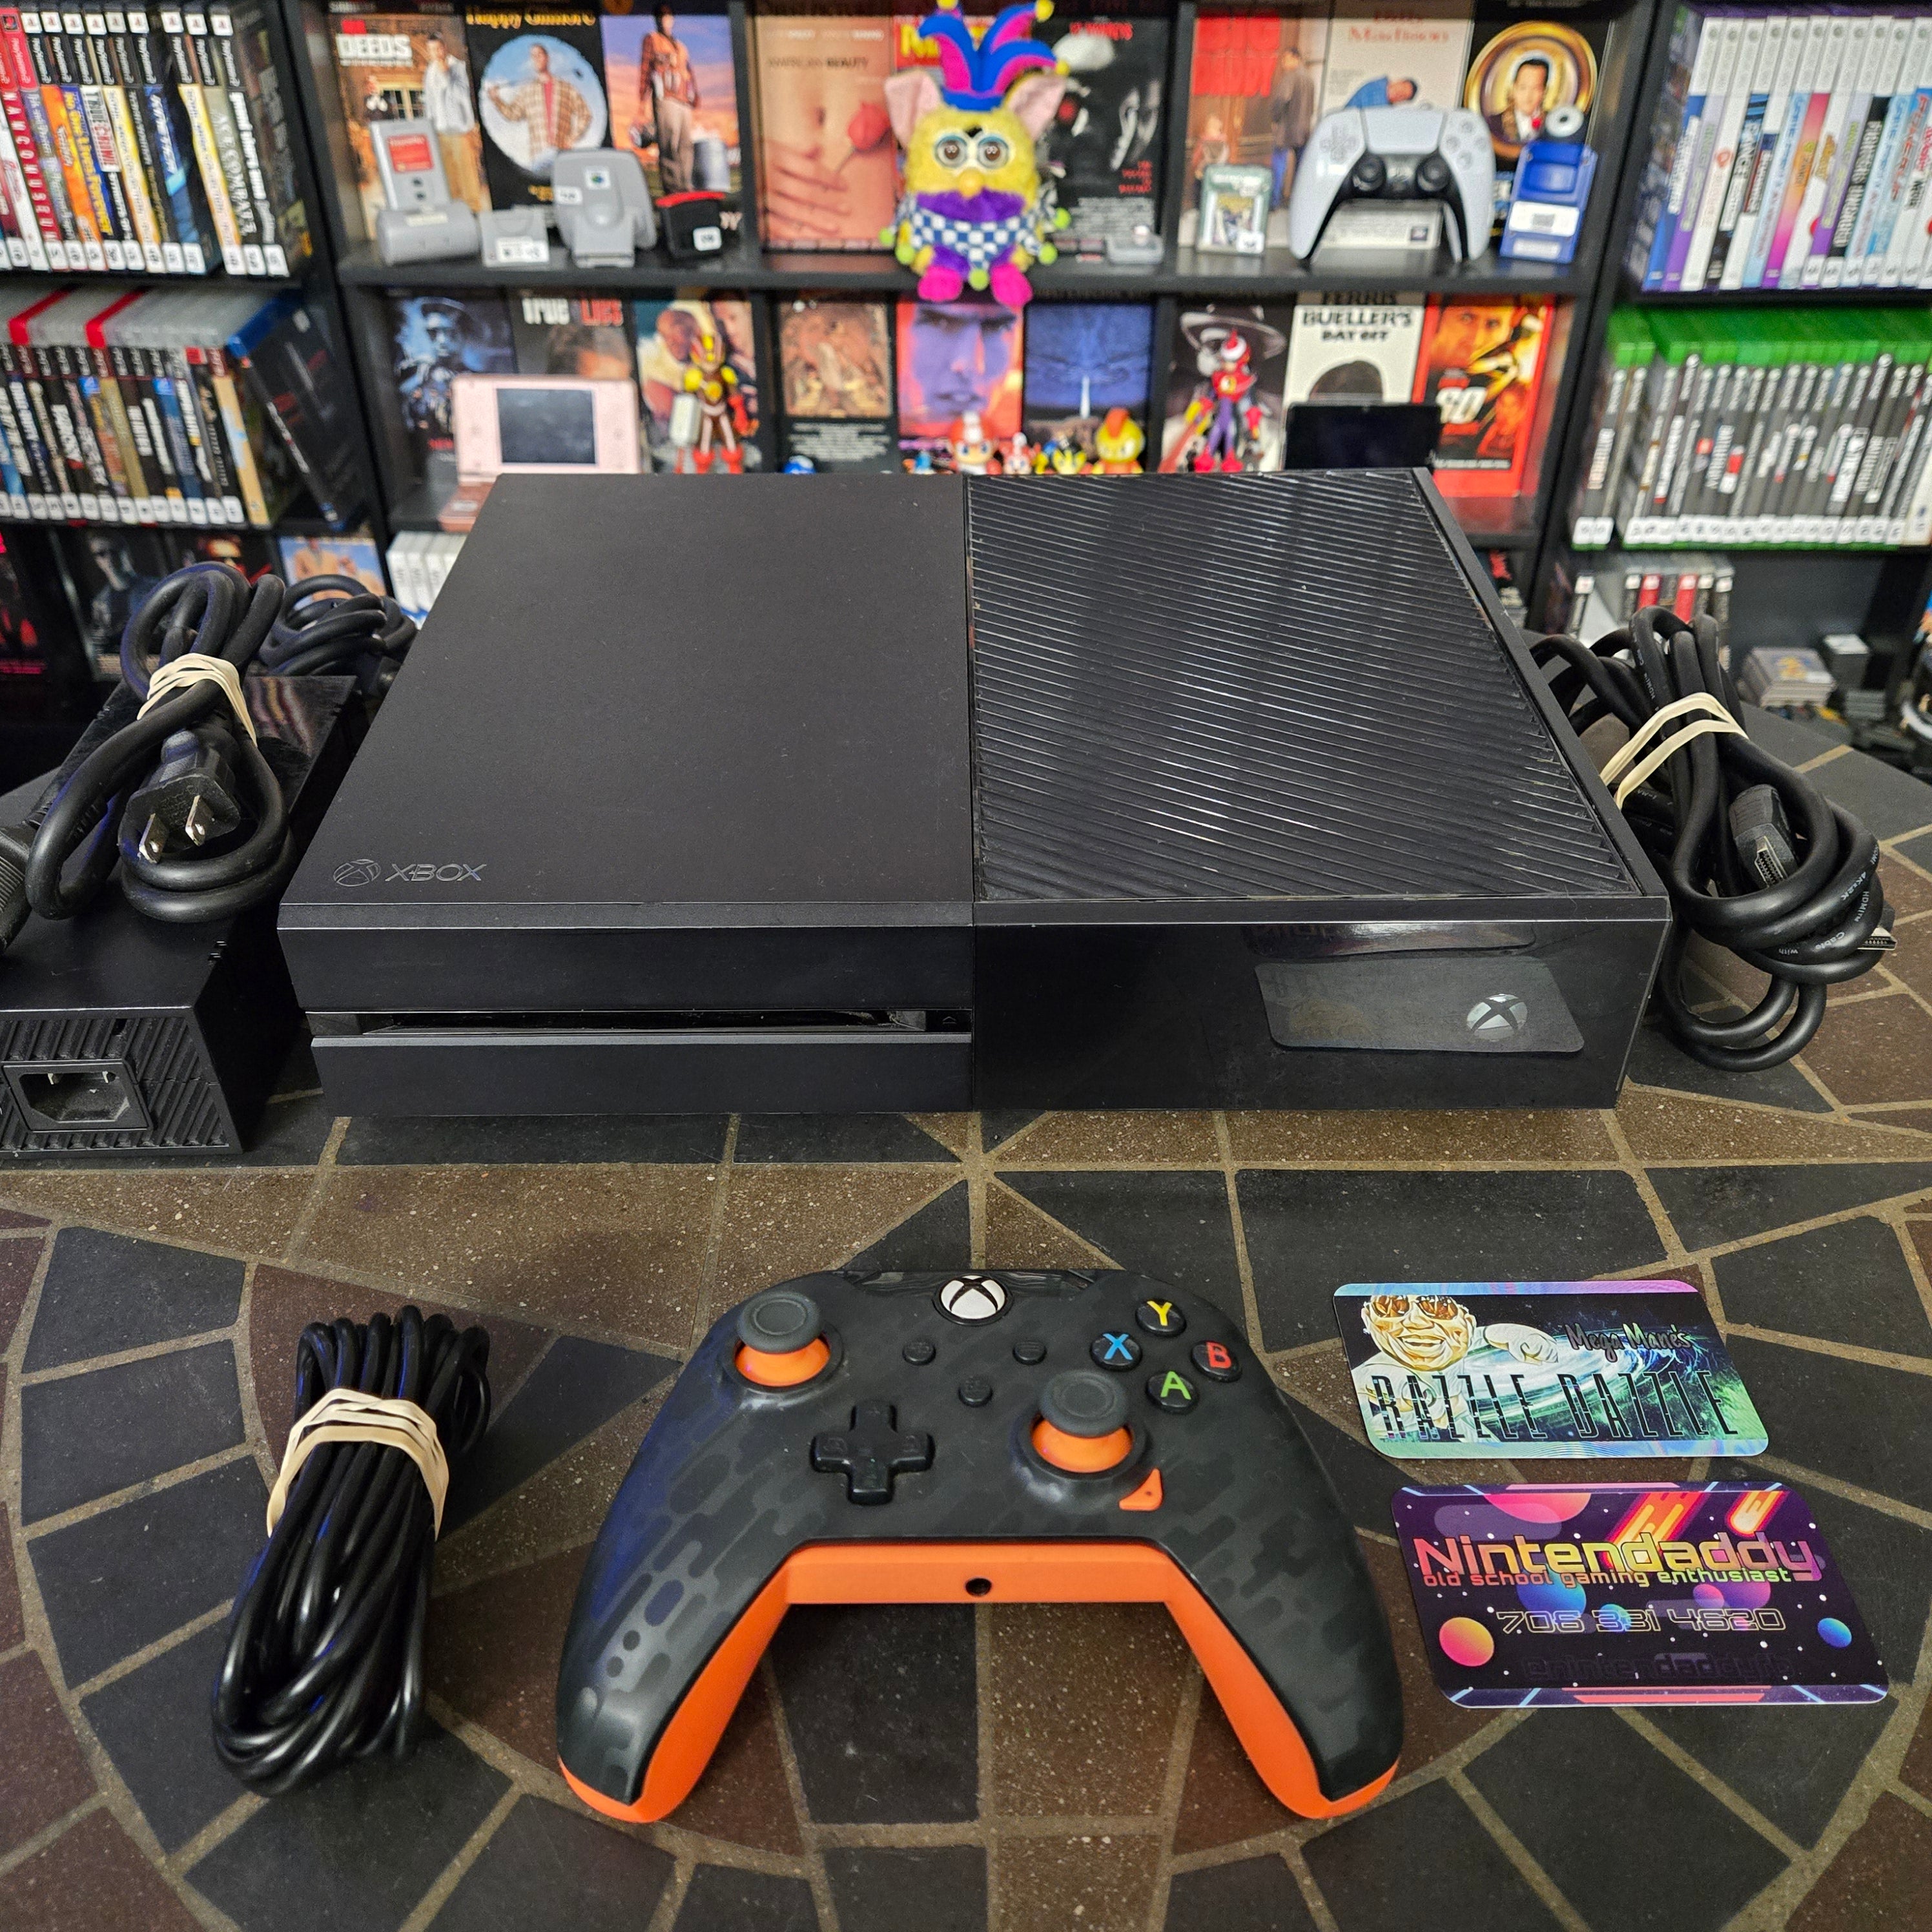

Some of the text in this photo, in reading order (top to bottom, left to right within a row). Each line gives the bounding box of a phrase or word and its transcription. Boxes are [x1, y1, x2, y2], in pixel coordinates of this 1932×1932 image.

[385, 863, 487, 882] XBOX
[1146, 1300, 1173, 1326] Y
[1102, 1332, 1133, 1360] X
[1206, 1341, 1233, 1370] B
[1565, 1322, 1625, 1362] Mega
[1160, 1371, 1191, 1400] A
[1370, 1370, 1739, 1441] RAZZLE DAZZLE
[1413, 1531, 1824, 1582] Nintendaddy
[1423, 1568, 1793, 1588] old school gaming enthusiast
[1496, 1610, 1585, 1635] 706
[1667, 1607, 1786, 1632] 4620
